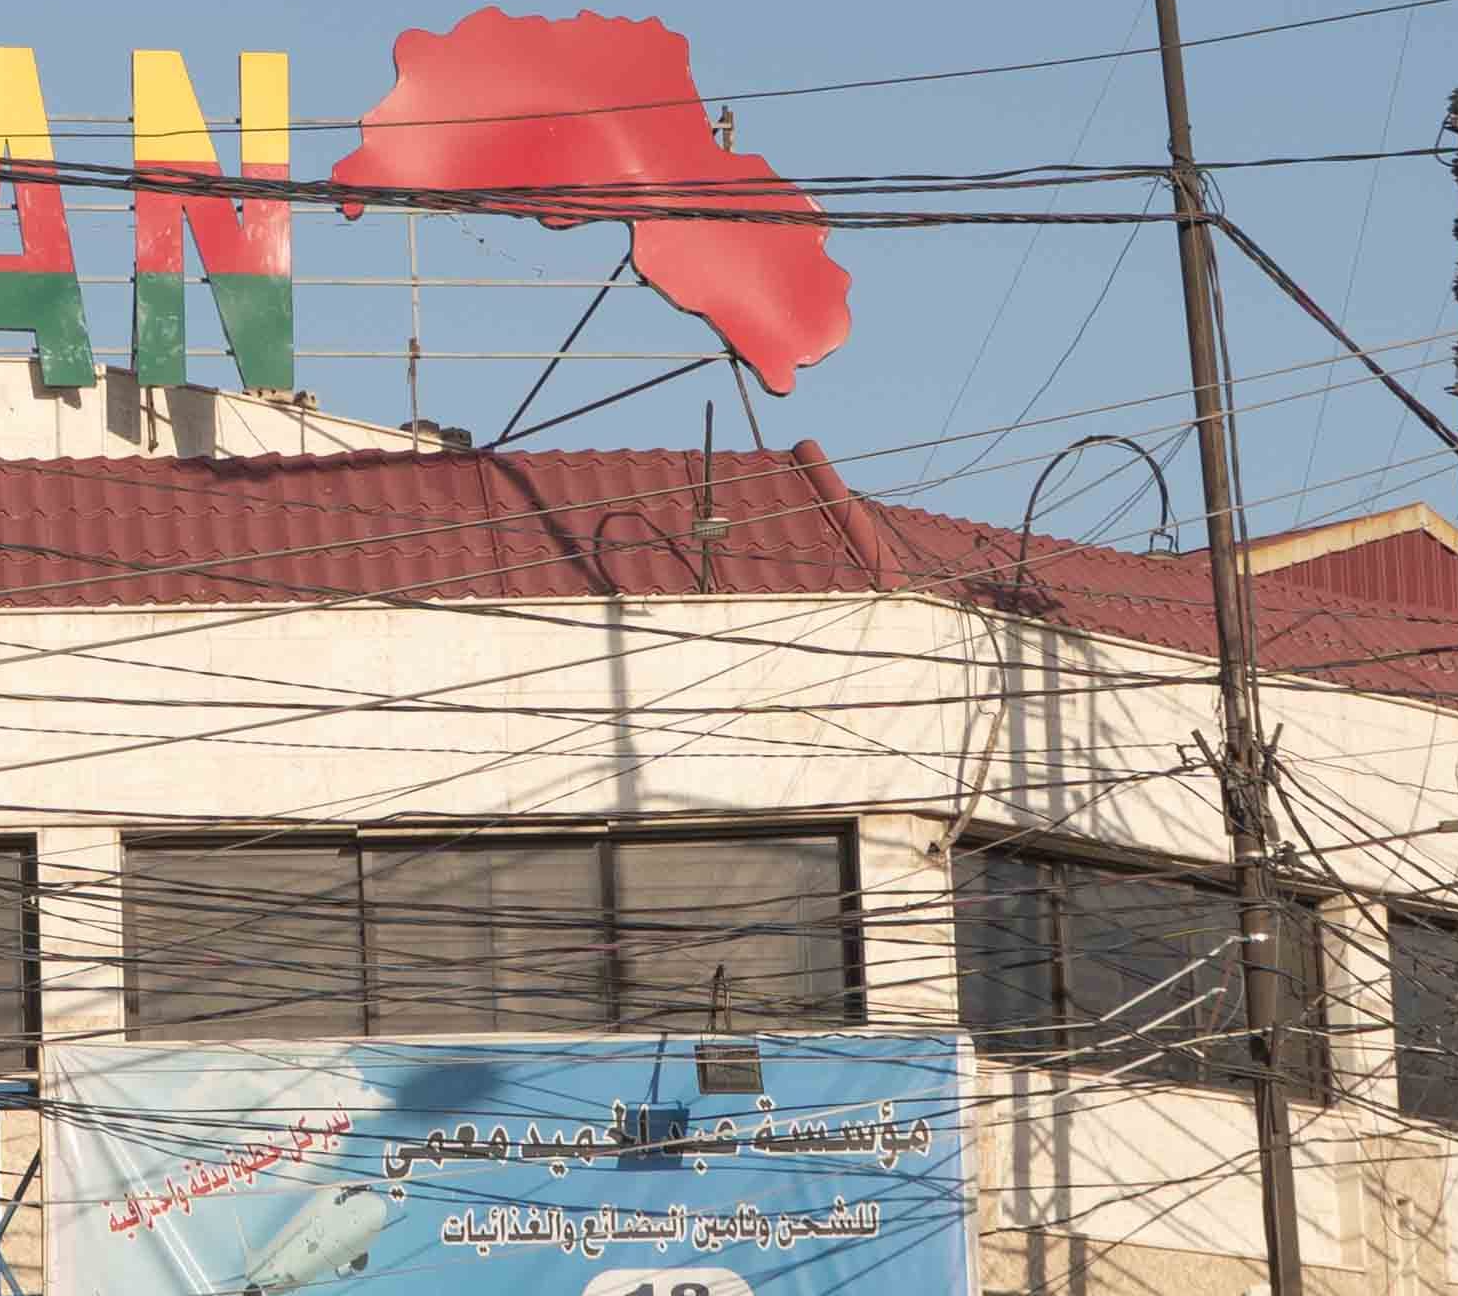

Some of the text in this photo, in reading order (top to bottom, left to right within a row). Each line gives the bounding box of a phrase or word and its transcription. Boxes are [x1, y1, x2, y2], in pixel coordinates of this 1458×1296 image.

[520, 1099, 650, 1177] الحميد
[661, 1118, 740, 1174] عبد
[751, 1095, 931, 1169] مؤسسة
[183, 1160, 235, 1196] بدقة
[225, 1134, 282, 1185] خطوة
[441, 1205, 577, 1256] والغذائيات
[580, 1203, 687, 1259] البضائع
[776, 1196, 880, 1249] للشحن
